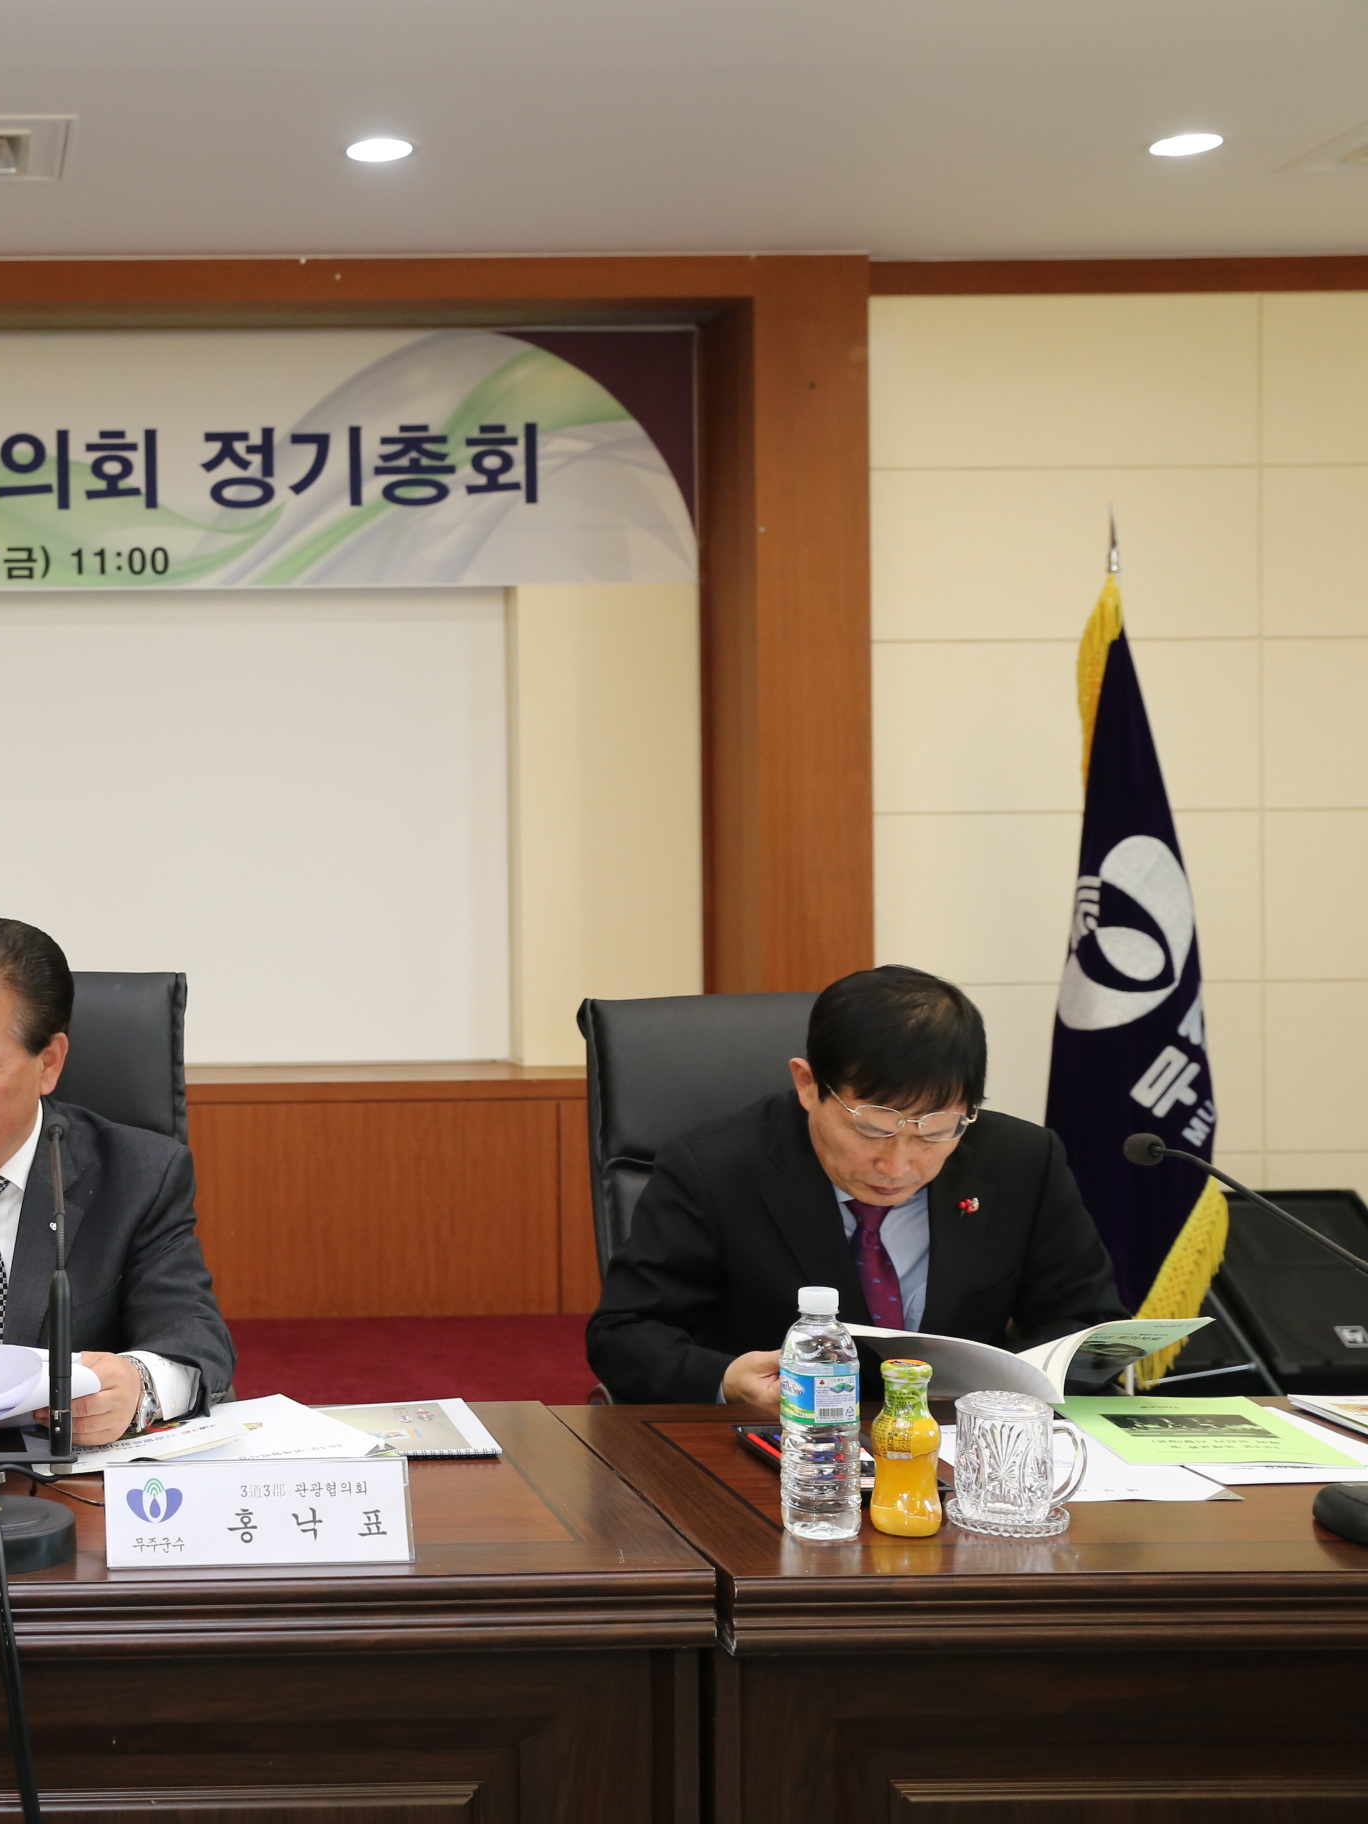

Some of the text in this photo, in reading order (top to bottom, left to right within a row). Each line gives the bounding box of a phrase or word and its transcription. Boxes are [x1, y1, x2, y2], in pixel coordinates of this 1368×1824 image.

[200, 422, 540, 509] 정기총회
[70, 546, 170, 576] 11:00
[239, 1480, 368, 1498] 3道3郡 관광협의회
[226, 1506, 389, 1544] 홍 낙 표
[132, 1536, 186, 1554] 무주군수
